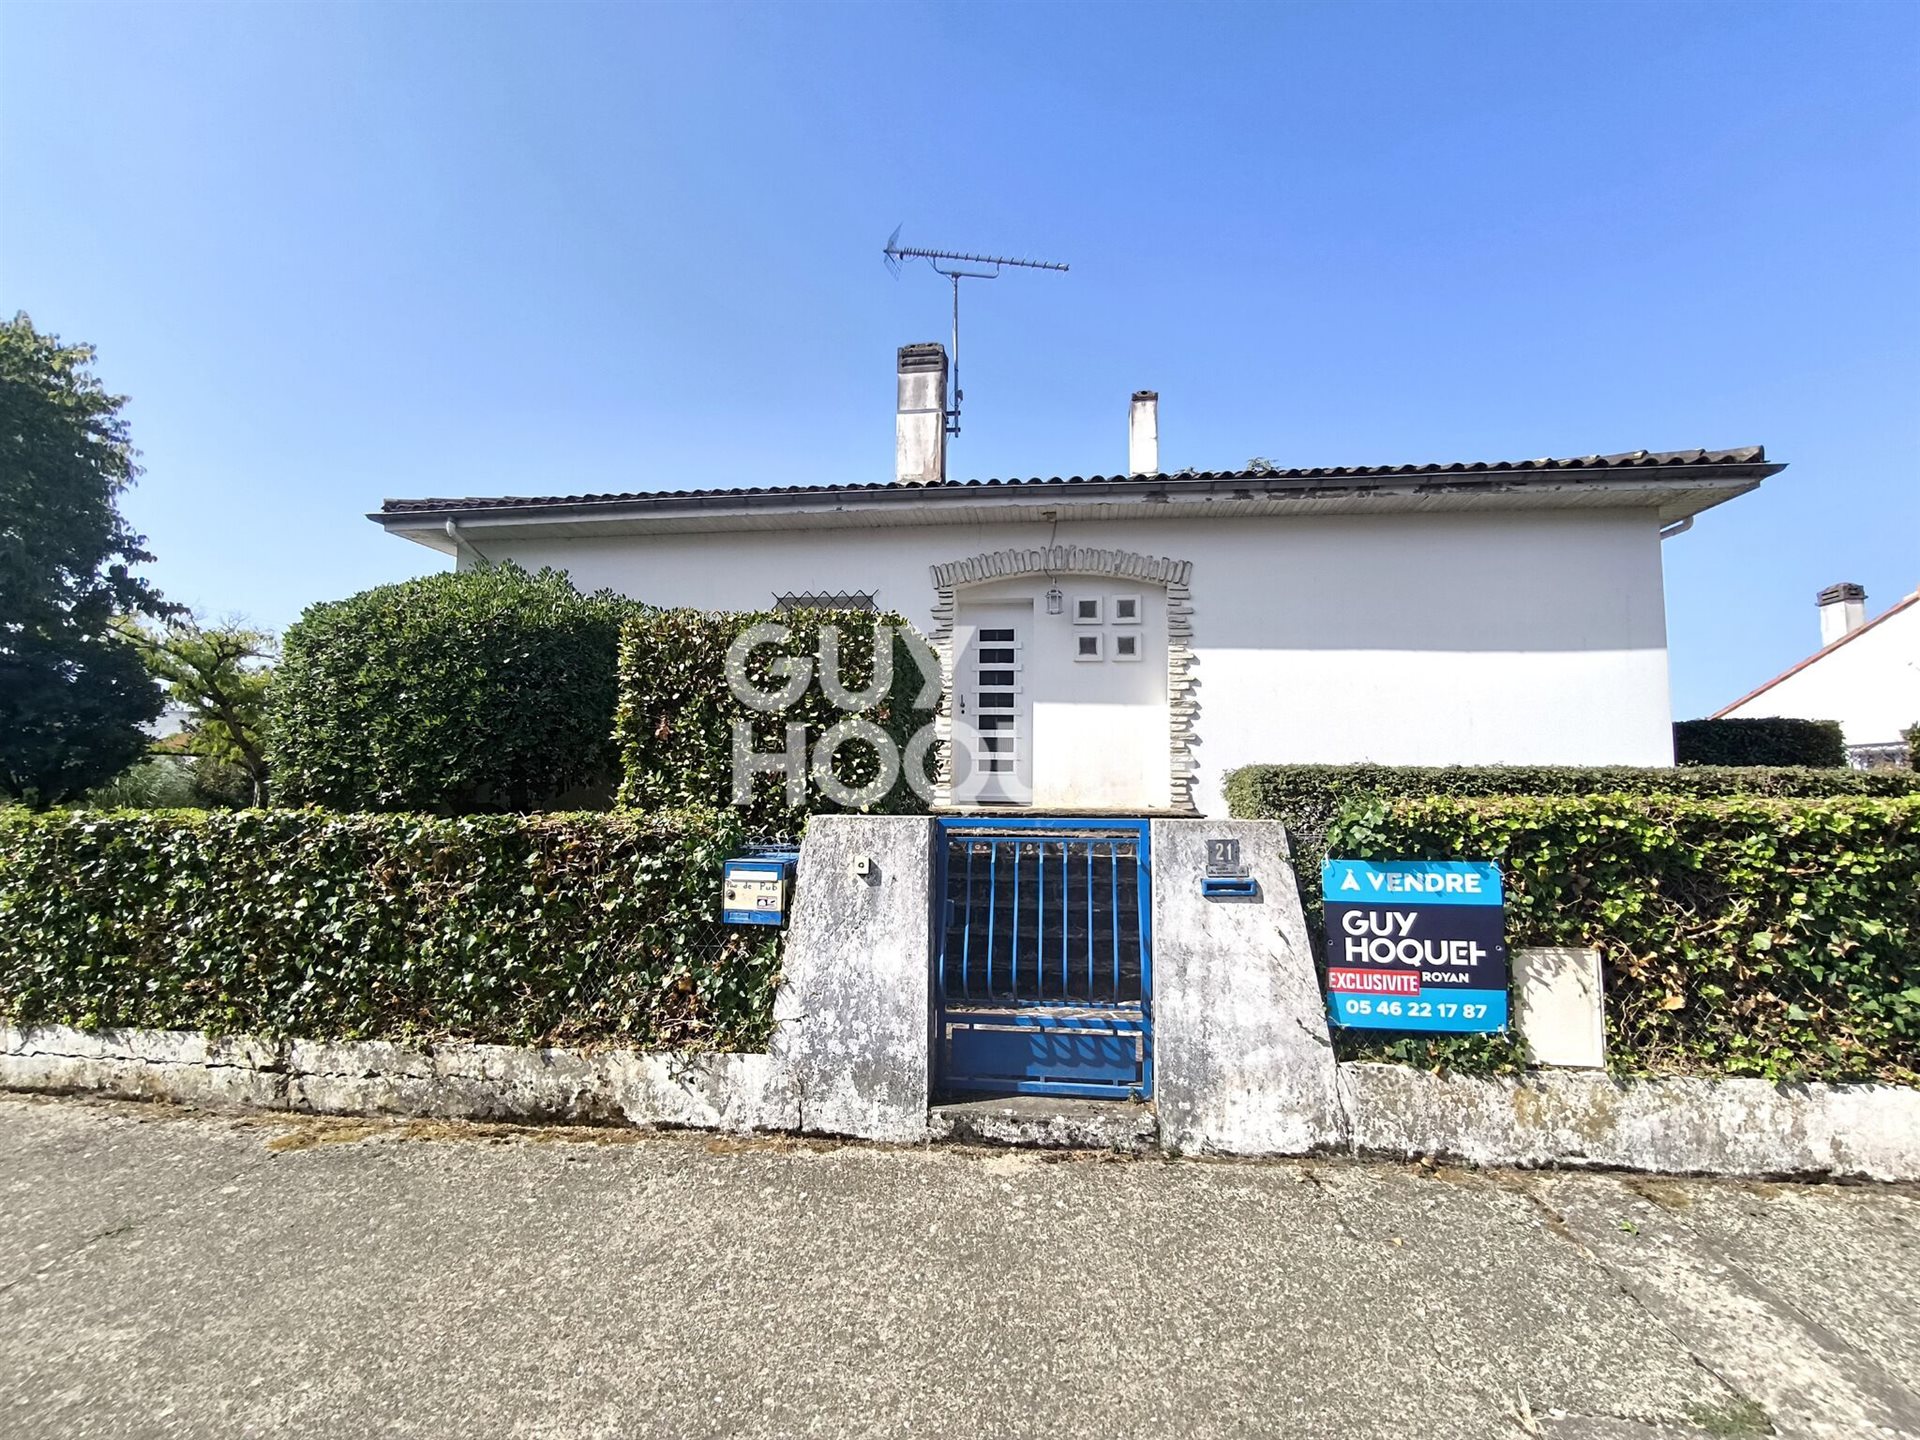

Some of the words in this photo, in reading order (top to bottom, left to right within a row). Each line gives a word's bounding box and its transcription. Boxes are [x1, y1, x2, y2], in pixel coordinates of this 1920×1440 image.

[1215, 843, 1233, 860] 21
[743, 881, 752, 889] de
[760, 882, 778, 891] Pub
[1340, 868, 1361, 891] À
[1366, 872, 1482, 893] VENDRE
[1342, 910, 1418, 936] GUY
[1345, 937, 1487, 967] HOQUET
[1328, 971, 1419, 992] EXCLUSIVITE
[1422, 971, 1470, 983] ROYAN
[1345, 1000, 1372, 1015] 05
[1376, 1001, 1403, 1016] 46
[1407, 1002, 1432, 1017] 22
[1437, 1003, 1458, 1018] 17
[1462, 1004, 1488, 1019] 87
